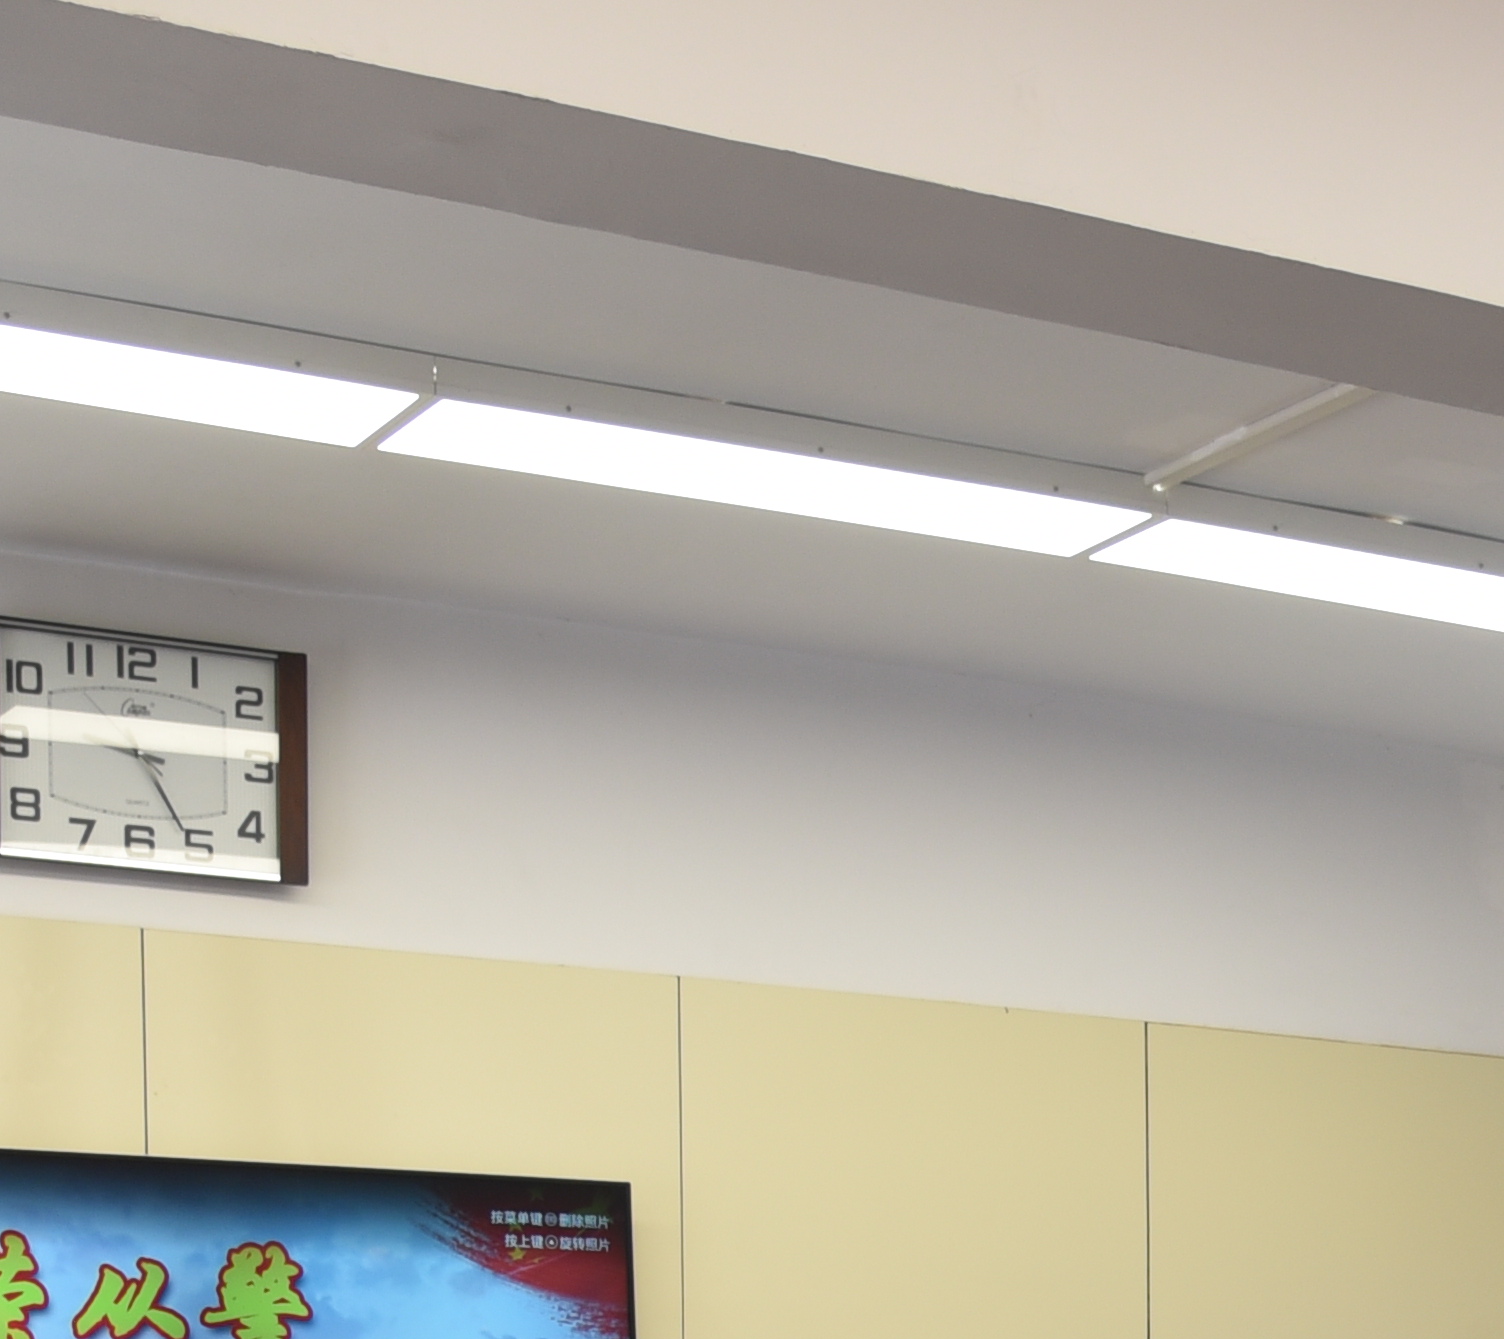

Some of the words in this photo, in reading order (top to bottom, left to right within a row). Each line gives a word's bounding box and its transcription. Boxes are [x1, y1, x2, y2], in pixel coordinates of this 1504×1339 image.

[6, 658, 43, 695] 10
[66, 641, 93, 677] 11
[116, 644, 157, 682] 12
[191, 656, 198, 689] 1
[235, 685, 263, 720] 2
[244, 749, 274, 784] 3
[9, 786, 41, 822] 8
[68, 817, 96, 851] 7
[124, 824, 155, 859] 6
[237, 810, 265, 843] 4
[184, 828, 213, 862] 5
